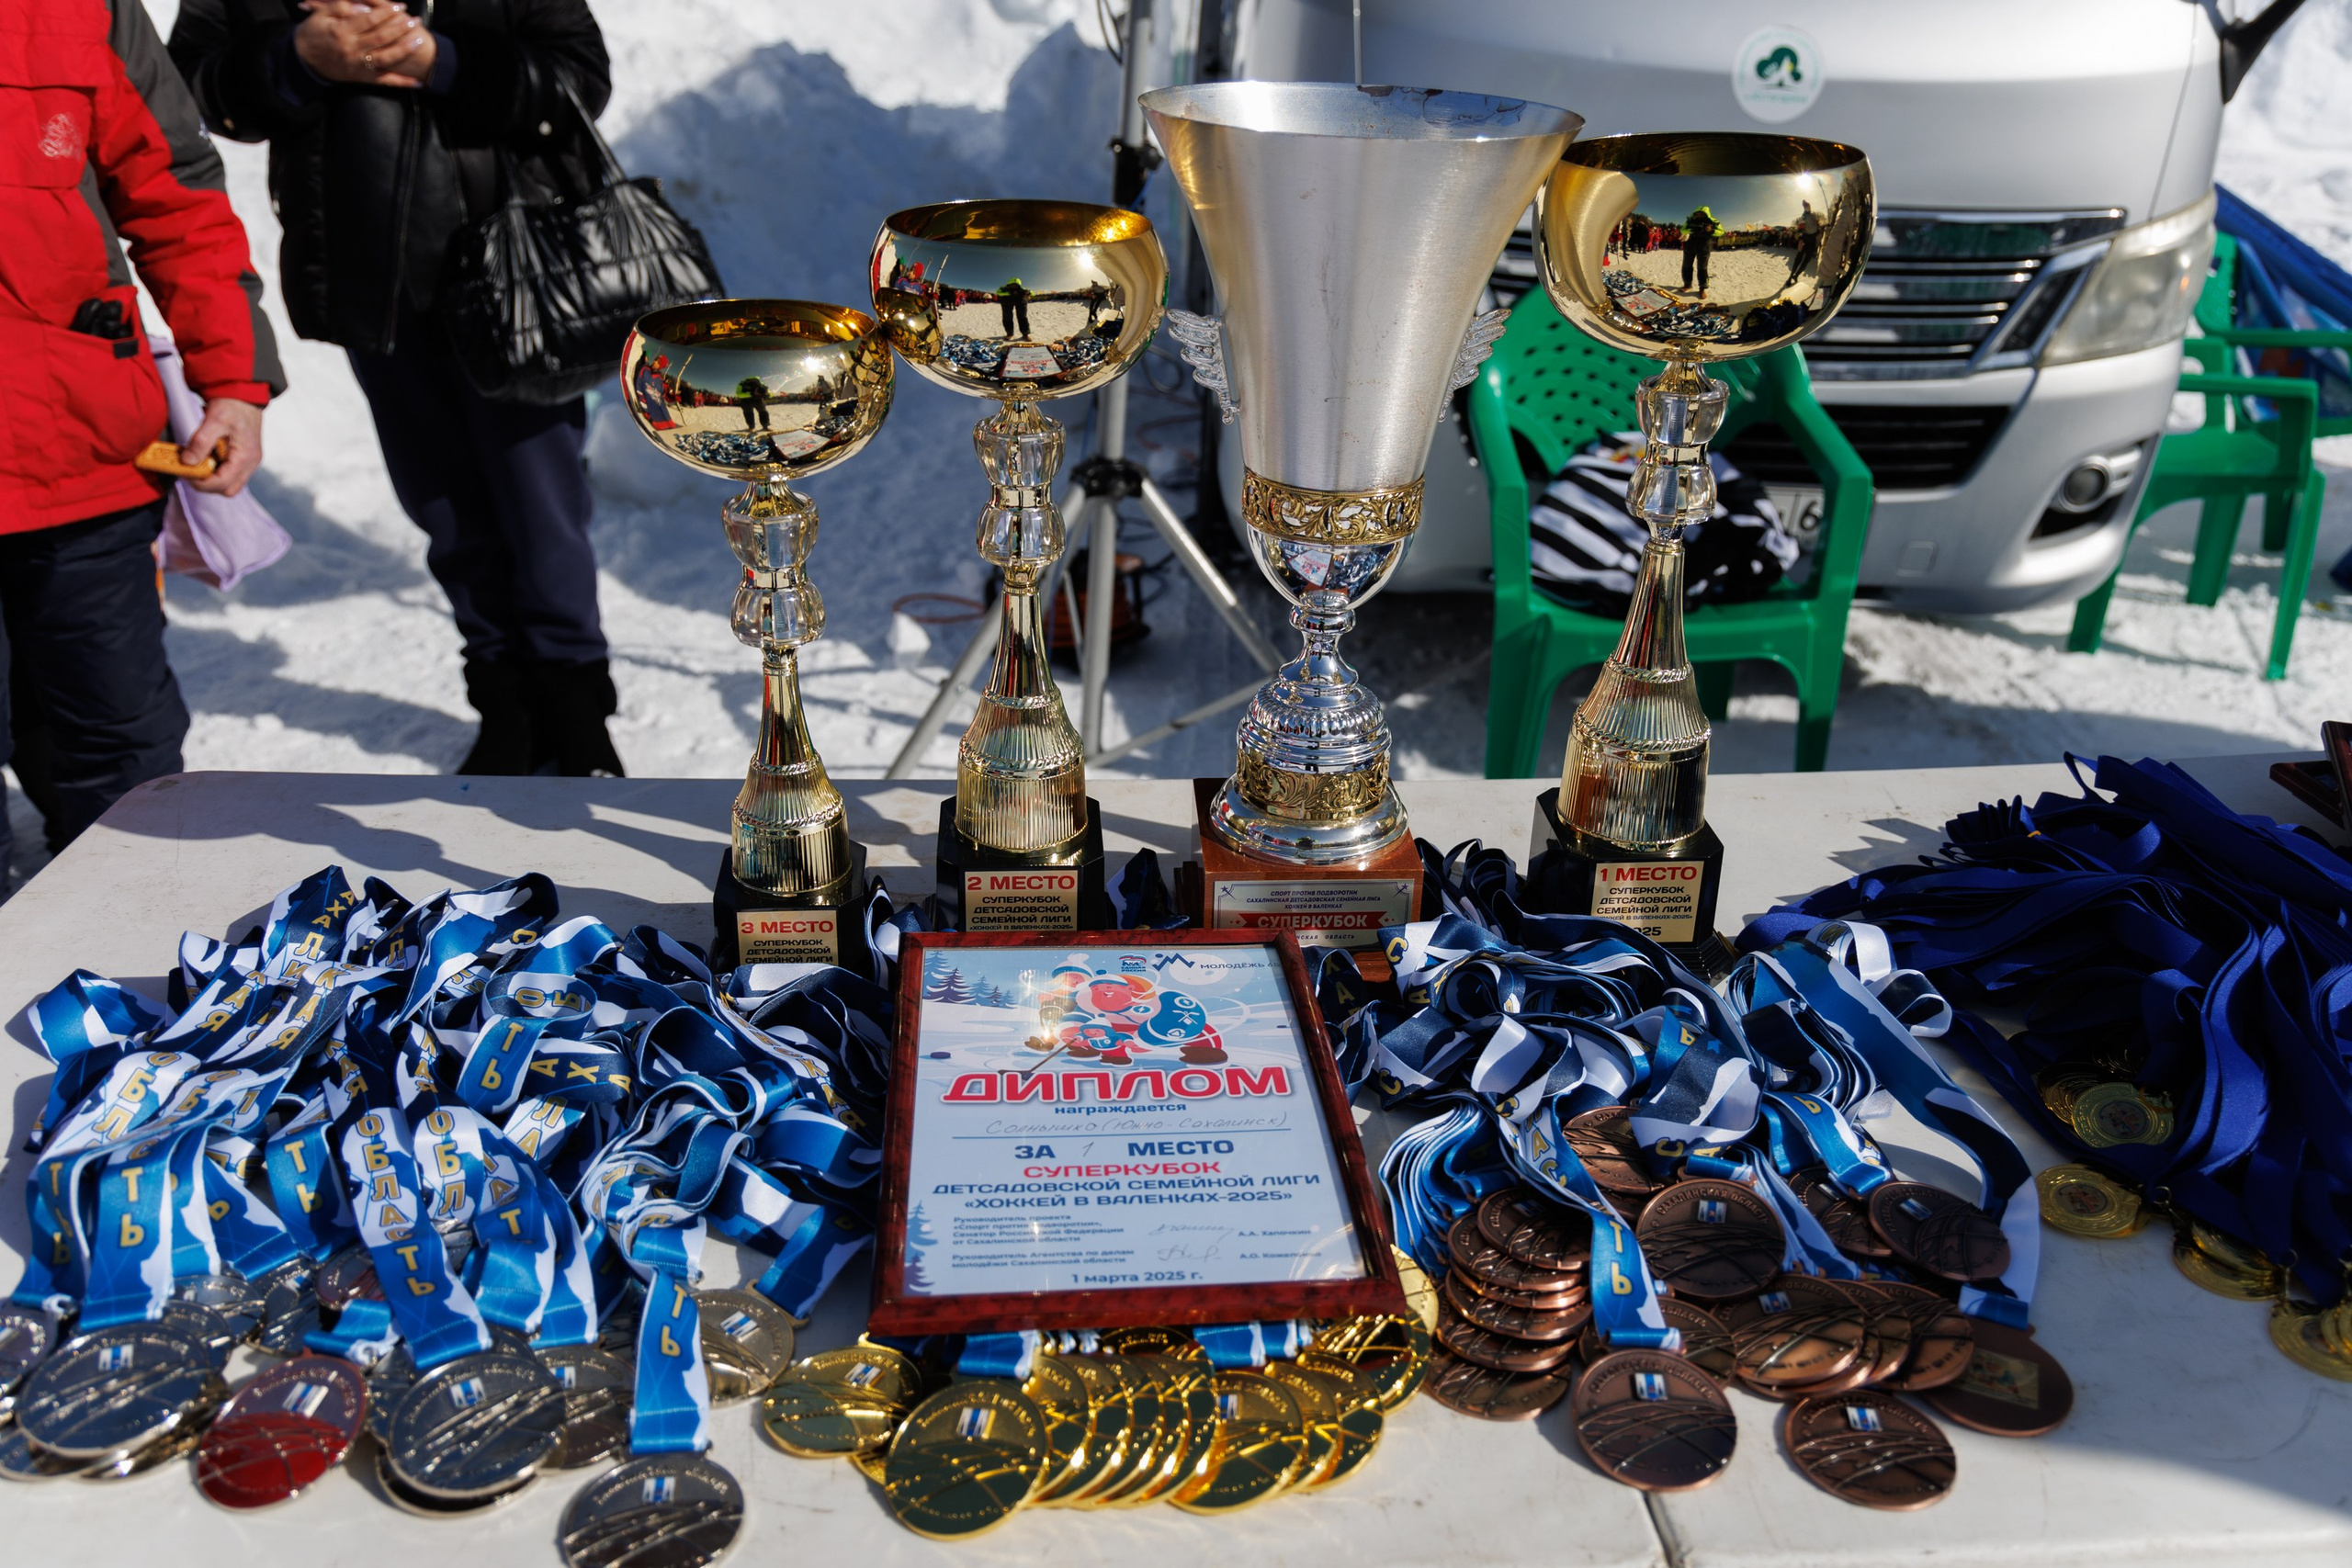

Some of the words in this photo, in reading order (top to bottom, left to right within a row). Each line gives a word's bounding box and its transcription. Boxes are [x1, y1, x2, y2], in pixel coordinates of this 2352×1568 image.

[1600, 868, 1607, 881] 1
[1615, 866, 1697, 881] МЕСТО
[967, 876, 982, 891] 2
[989, 875, 1075, 890] МЕСТО
[1609, 886, 1685, 895] СУПЕРКУБОК
[982, 896, 1060, 904] СУПЕРКУБОК
[1599, 895, 1690, 905] ДЕТСАДОВСКОЙ
[973, 904, 1069, 914] ДЕТСАДОВСКОЙ
[1597, 905, 1659, 914] СЕМЕЙНОЙ
[971, 914, 1037, 924] СЕМЕЙНОЙ
[1040, 915, 1071, 923] ЛИГИ
[1257, 914, 1367, 929] СУПЕРКУБОК
[741, 921, 754, 934] 3
[761, 920, 833, 933] МЕСТО
[753, 939, 823, 947] СУПЕРКУБОК
[746, 946, 831, 955] ДЕТСАДОВСКОЙ
[745, 955, 803, 964] СЕМЕЙНОЙ
[806, 955, 833, 964] ЛИГИ
[942, 1066, 1289, 1101] ДИПЛОМ
[1055, 1103, 1187, 1115] награждается
[1014, 1145, 1056, 1159] ЗА
[1127, 1140, 1235, 1156] МЕСТО
[1023, 1162, 1221, 1179] СУПЕРКУБОК
[933, 1179, 1120, 1194] ДЕТСАДОВСКОЙ
[1127, 1176, 1254, 1190] СЕМЕЙНОЙ
[1261, 1175, 1319, 1186] ЛИГИ
[356, 1114, 436, 1296] ОБЛАСТЬ
[965, 1195, 1066, 1209] «ХОККЕЙ
[1074, 1196, 1089, 1206] В
[1097, 1190, 1293, 1205] ВАЛЕНКАХ-2025»
[1072, 1274, 1079, 1282] 1
[1084, 1274, 1138, 1284] марта
[1144, 1271, 1185, 1281] 2025
